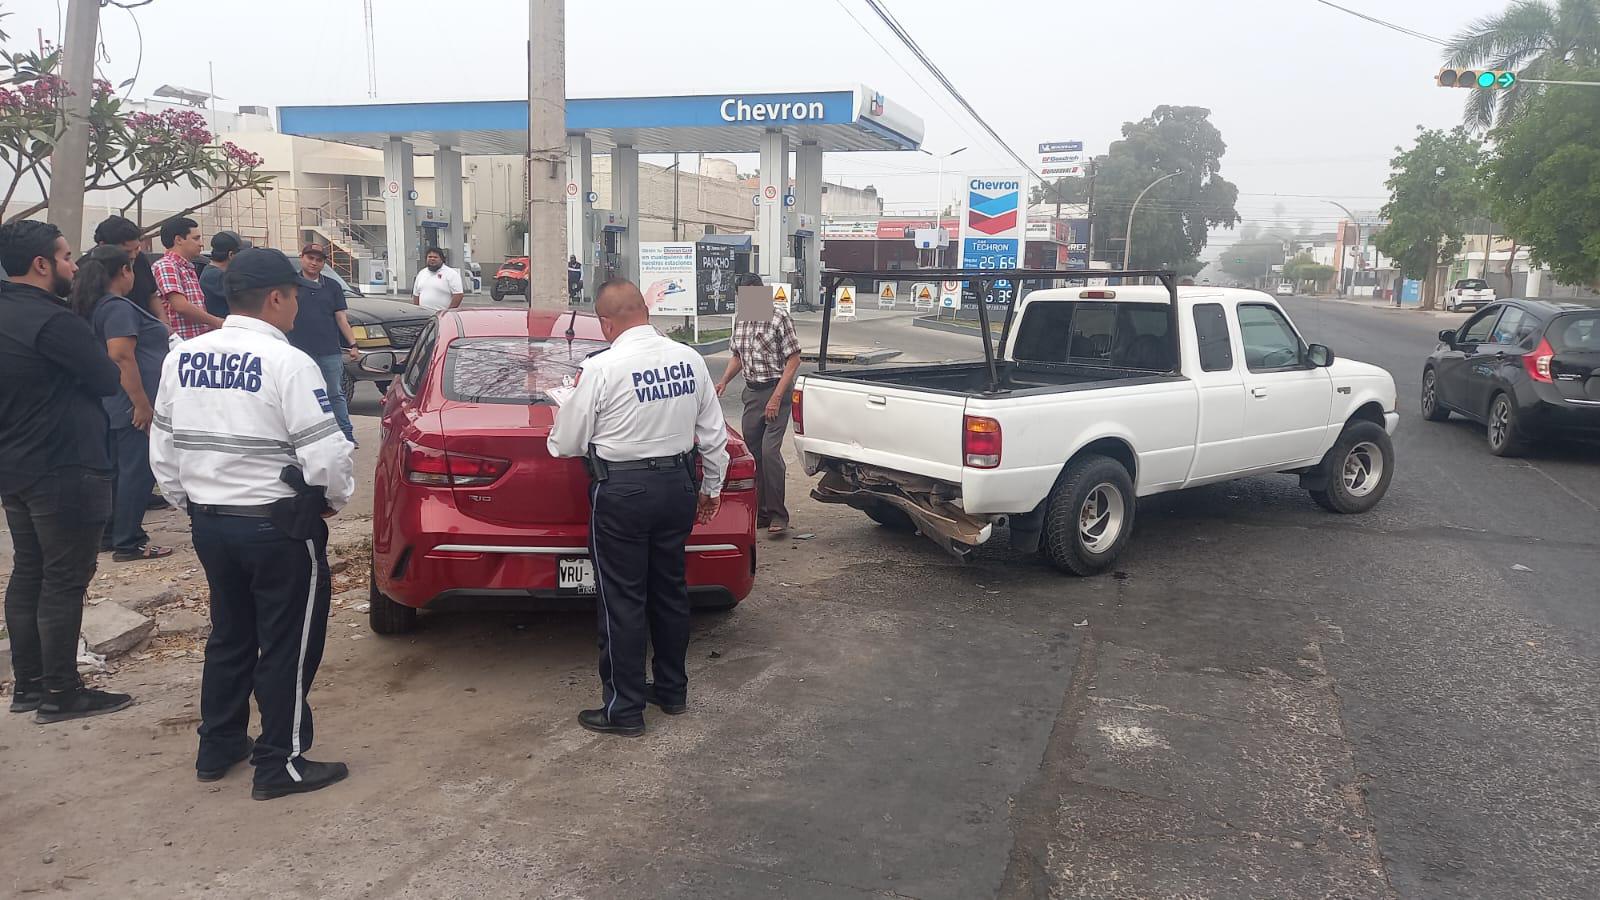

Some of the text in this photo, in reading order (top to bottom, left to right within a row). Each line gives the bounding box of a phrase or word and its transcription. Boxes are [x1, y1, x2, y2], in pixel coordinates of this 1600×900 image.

[720, 98, 824, 121] Chevron
[970, 179, 1019, 190] Chevron
[973, 242, 1009, 252] TECHRON
[702, 256, 730, 269] PANCHO
[979, 256, 1016, 269] 25.65
[178, 352, 262, 376] POLICÍA
[178, 370, 262, 393] VIALIDAD
[631, 361, 695, 387] POLICÍA
[635, 379, 696, 403] VIALIDAD
[468, 494, 492, 502] RIO
